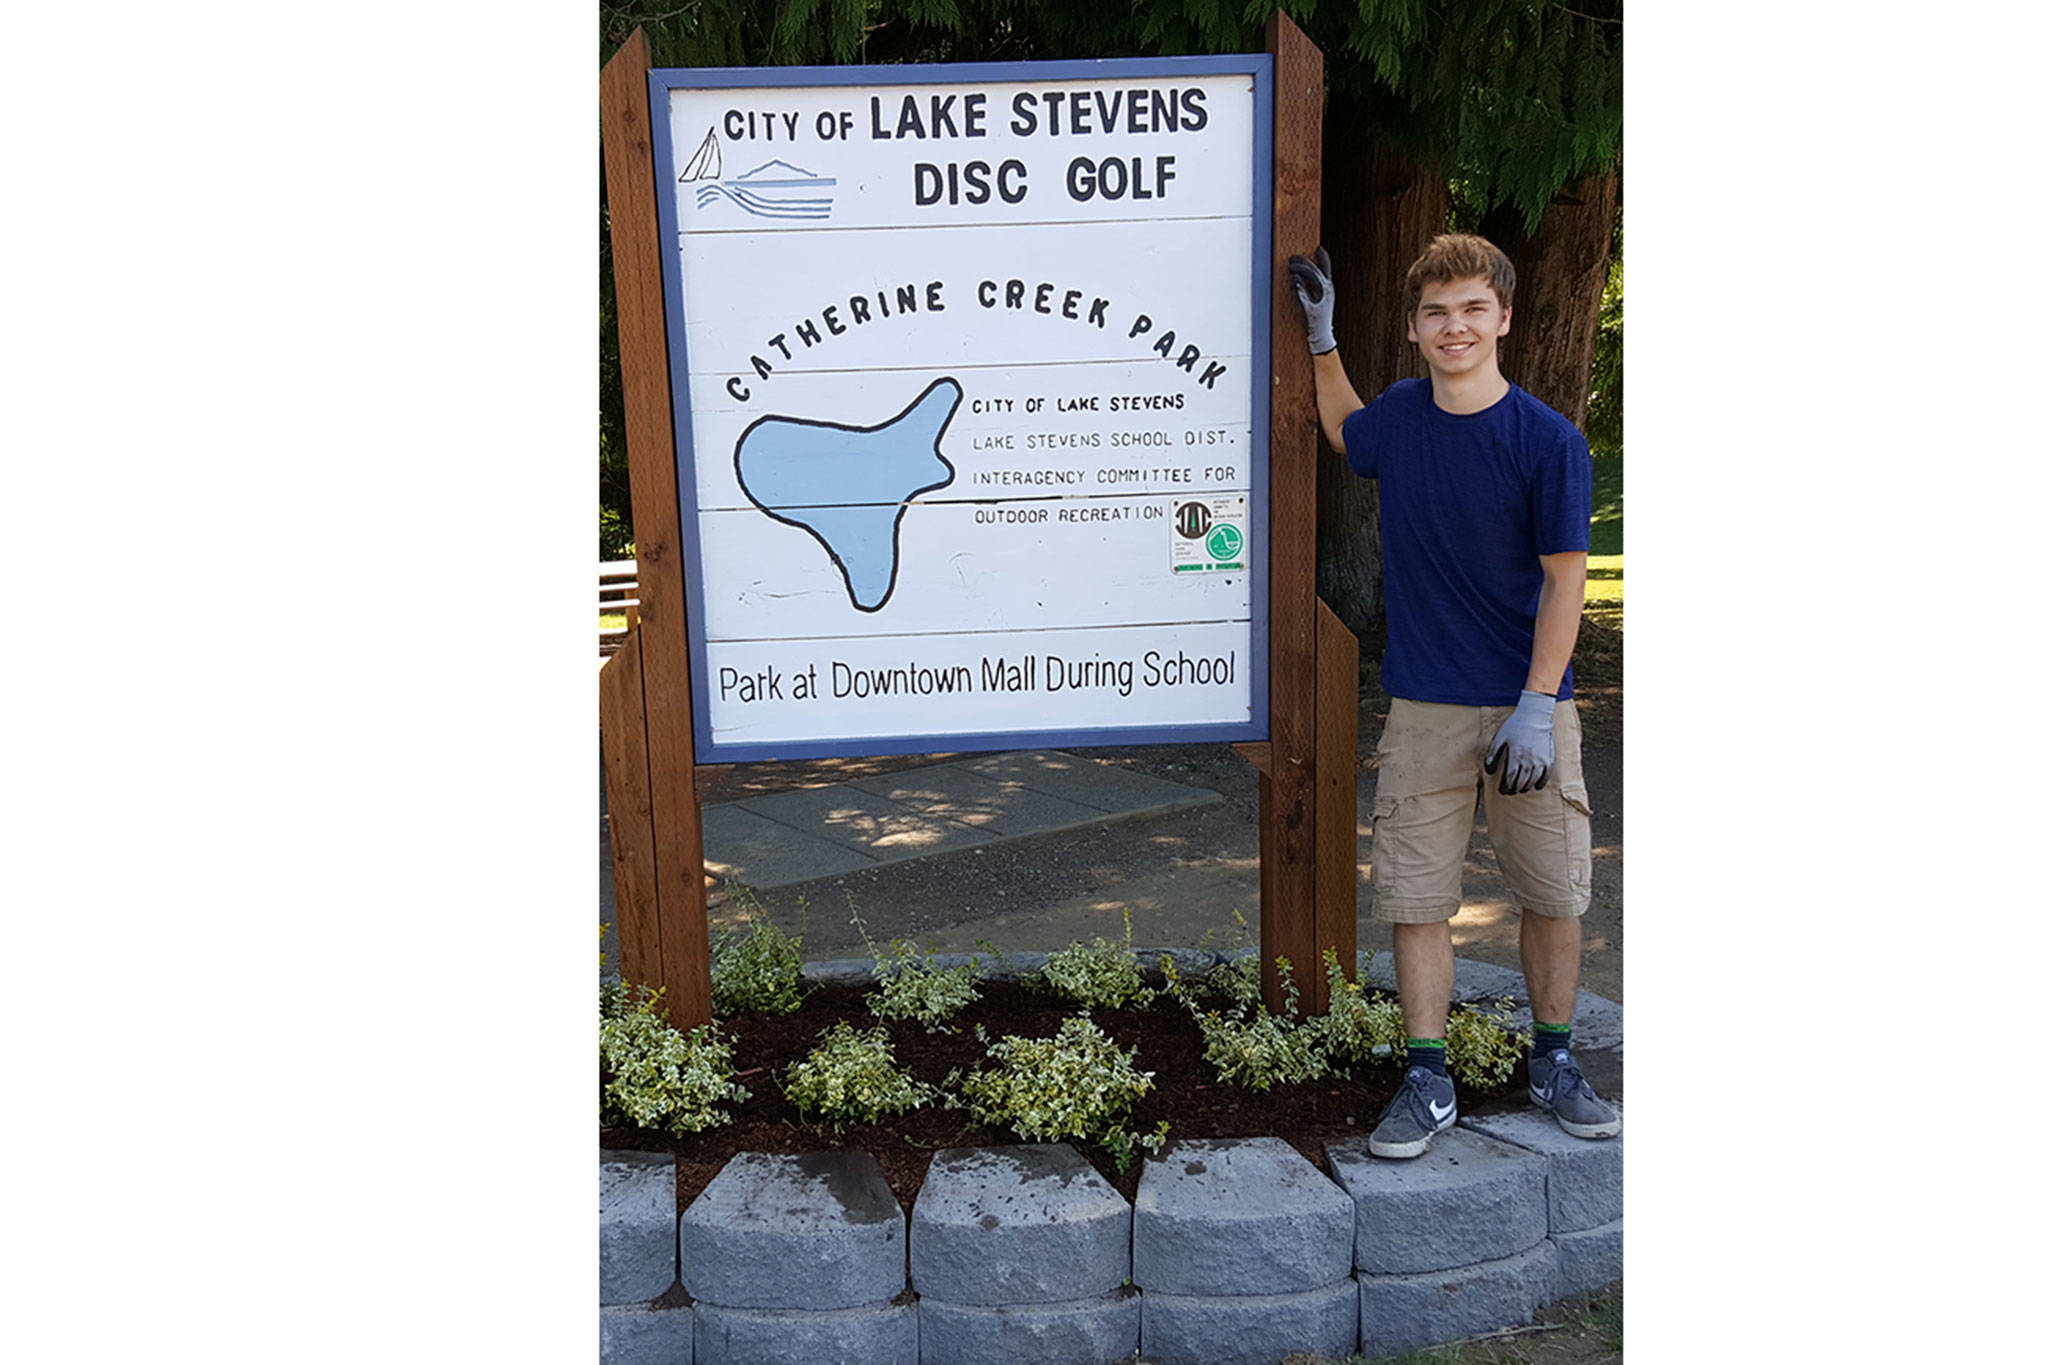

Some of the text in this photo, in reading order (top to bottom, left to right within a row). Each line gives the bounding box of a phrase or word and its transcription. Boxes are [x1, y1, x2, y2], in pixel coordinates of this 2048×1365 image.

[723, 88, 1208, 142] CITY OF LAKE STEVENS
[914, 155, 1176, 206] DISC GOLF
[726, 279, 1227, 402] CATHERINE CREEK PARK
[972, 393, 1185, 414] CITY OF LAKE STEVENS
[973, 429, 1235, 450] LAKE STEVENS SCHOOL DIST.
[973, 465, 1236, 486] INTERAGENCY COMMITTEE FOR
[975, 508, 1049, 524] OUTDOOR
[1058, 505, 1163, 523] RECREATION
[719, 649, 1235, 703] Park at Downtown Mall During School
